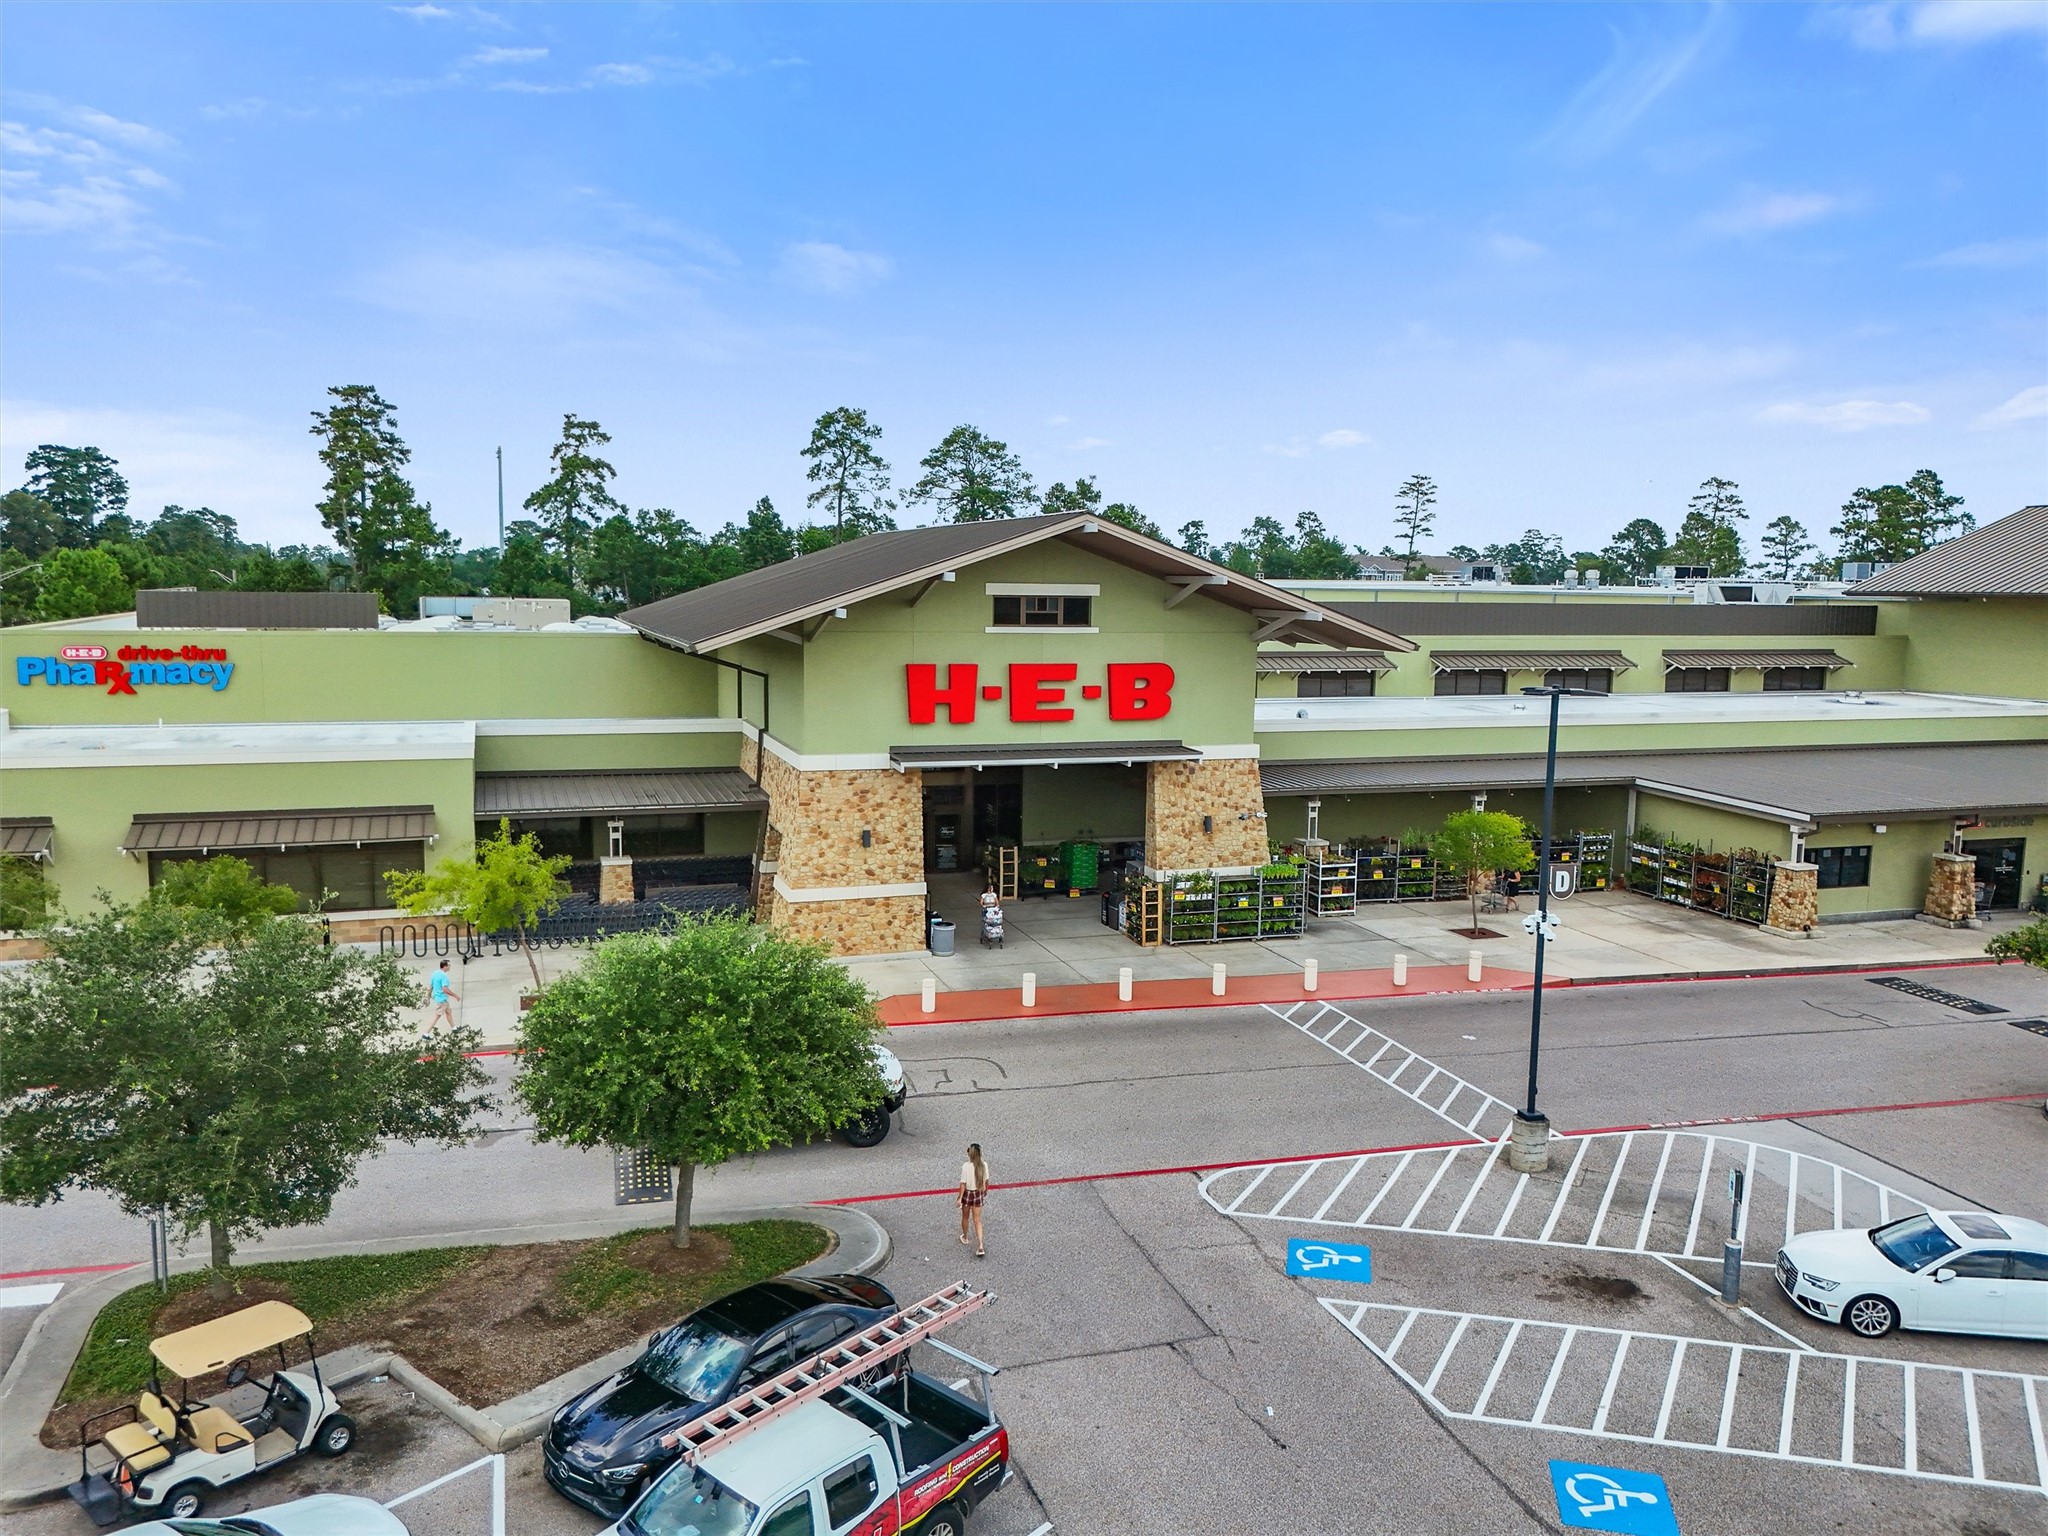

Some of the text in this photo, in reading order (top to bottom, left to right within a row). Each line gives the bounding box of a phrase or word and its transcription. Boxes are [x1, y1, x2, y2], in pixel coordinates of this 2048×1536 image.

[66, 648, 102, 657] H-E-B
[117, 645, 226, 660] drive-thru
[906, 663, 1175, 724] H-E-B
[1555, 870, 1570, 892] D
[914, 1477, 938, 1497] ROOFING
[952, 1444, 990, 1473] CONSTRUCTION
